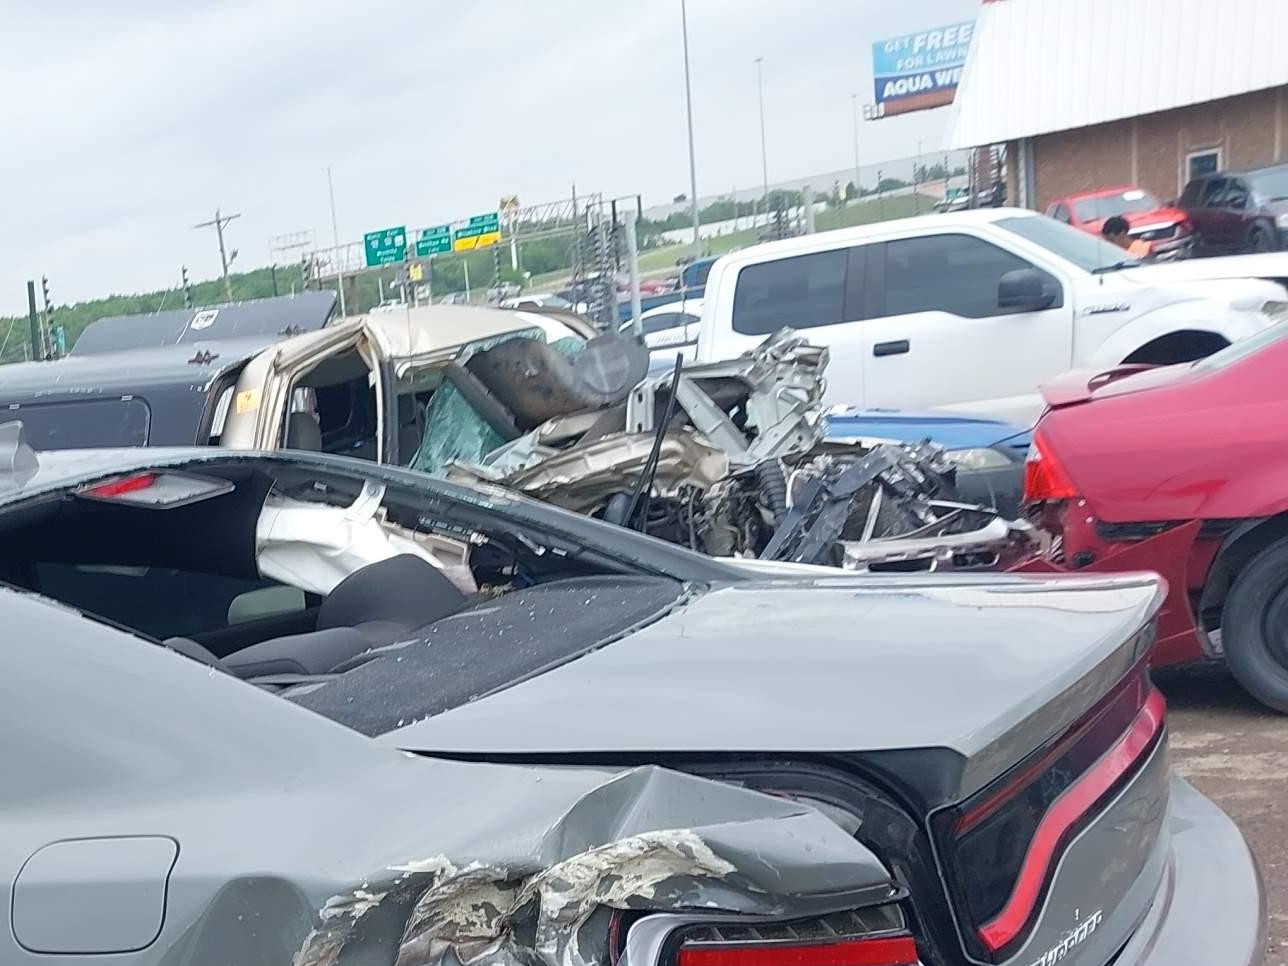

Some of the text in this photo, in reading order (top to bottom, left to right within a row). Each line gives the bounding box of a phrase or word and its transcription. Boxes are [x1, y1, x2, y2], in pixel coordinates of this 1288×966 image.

[885, 24, 974, 54] GET FREE
[896, 55, 924, 71] FOR
[883, 73, 933, 98] AQUA
